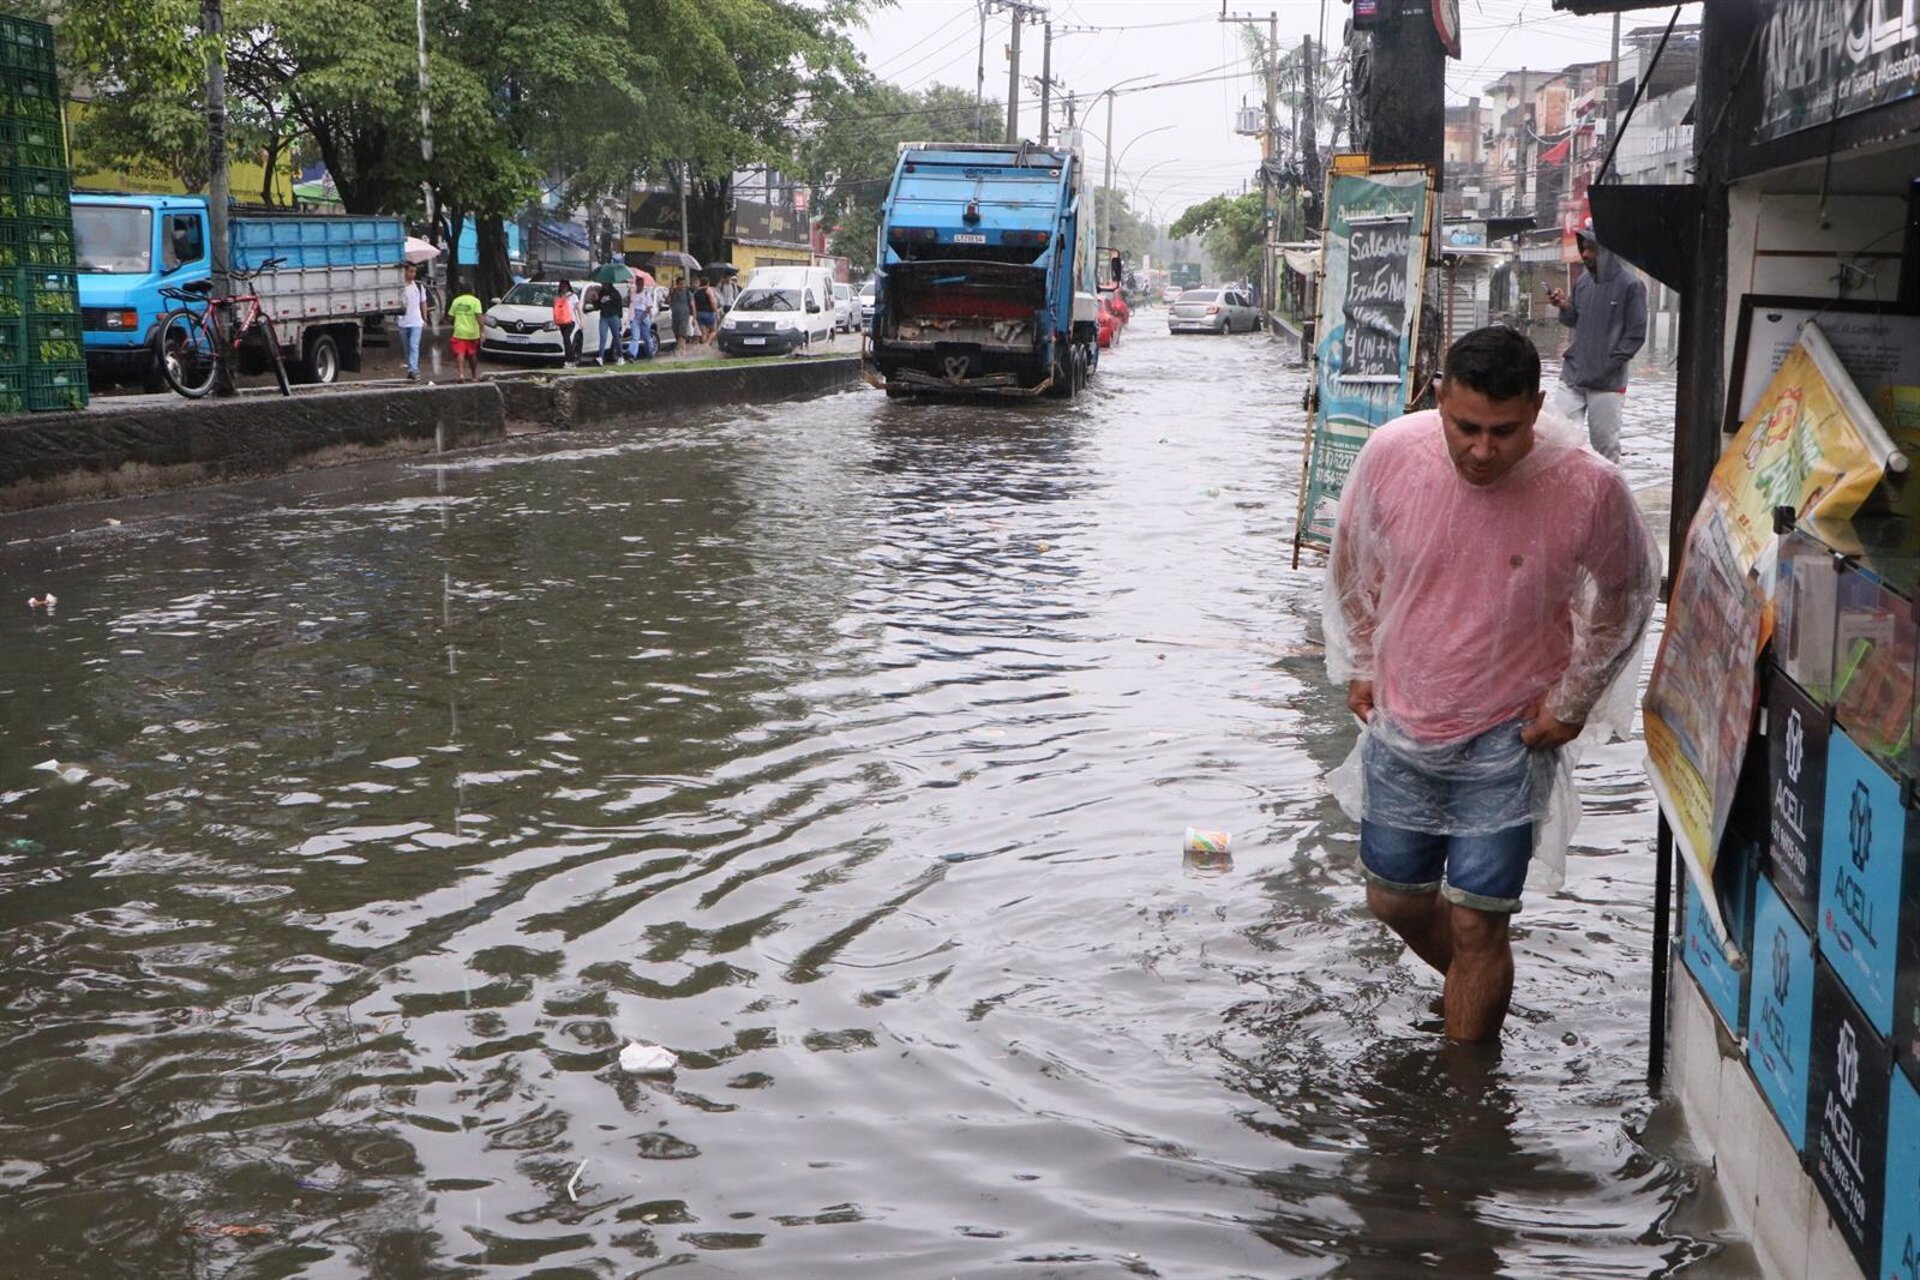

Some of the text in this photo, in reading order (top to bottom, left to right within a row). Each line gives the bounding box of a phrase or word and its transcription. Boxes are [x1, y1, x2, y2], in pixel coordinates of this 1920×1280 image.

[1775, 778, 1806, 842] ACELL
[1834, 865, 1878, 949] ACELL
[1761, 995, 1794, 1074] ACELL
[1824, 1090, 1864, 1184] ACELL
